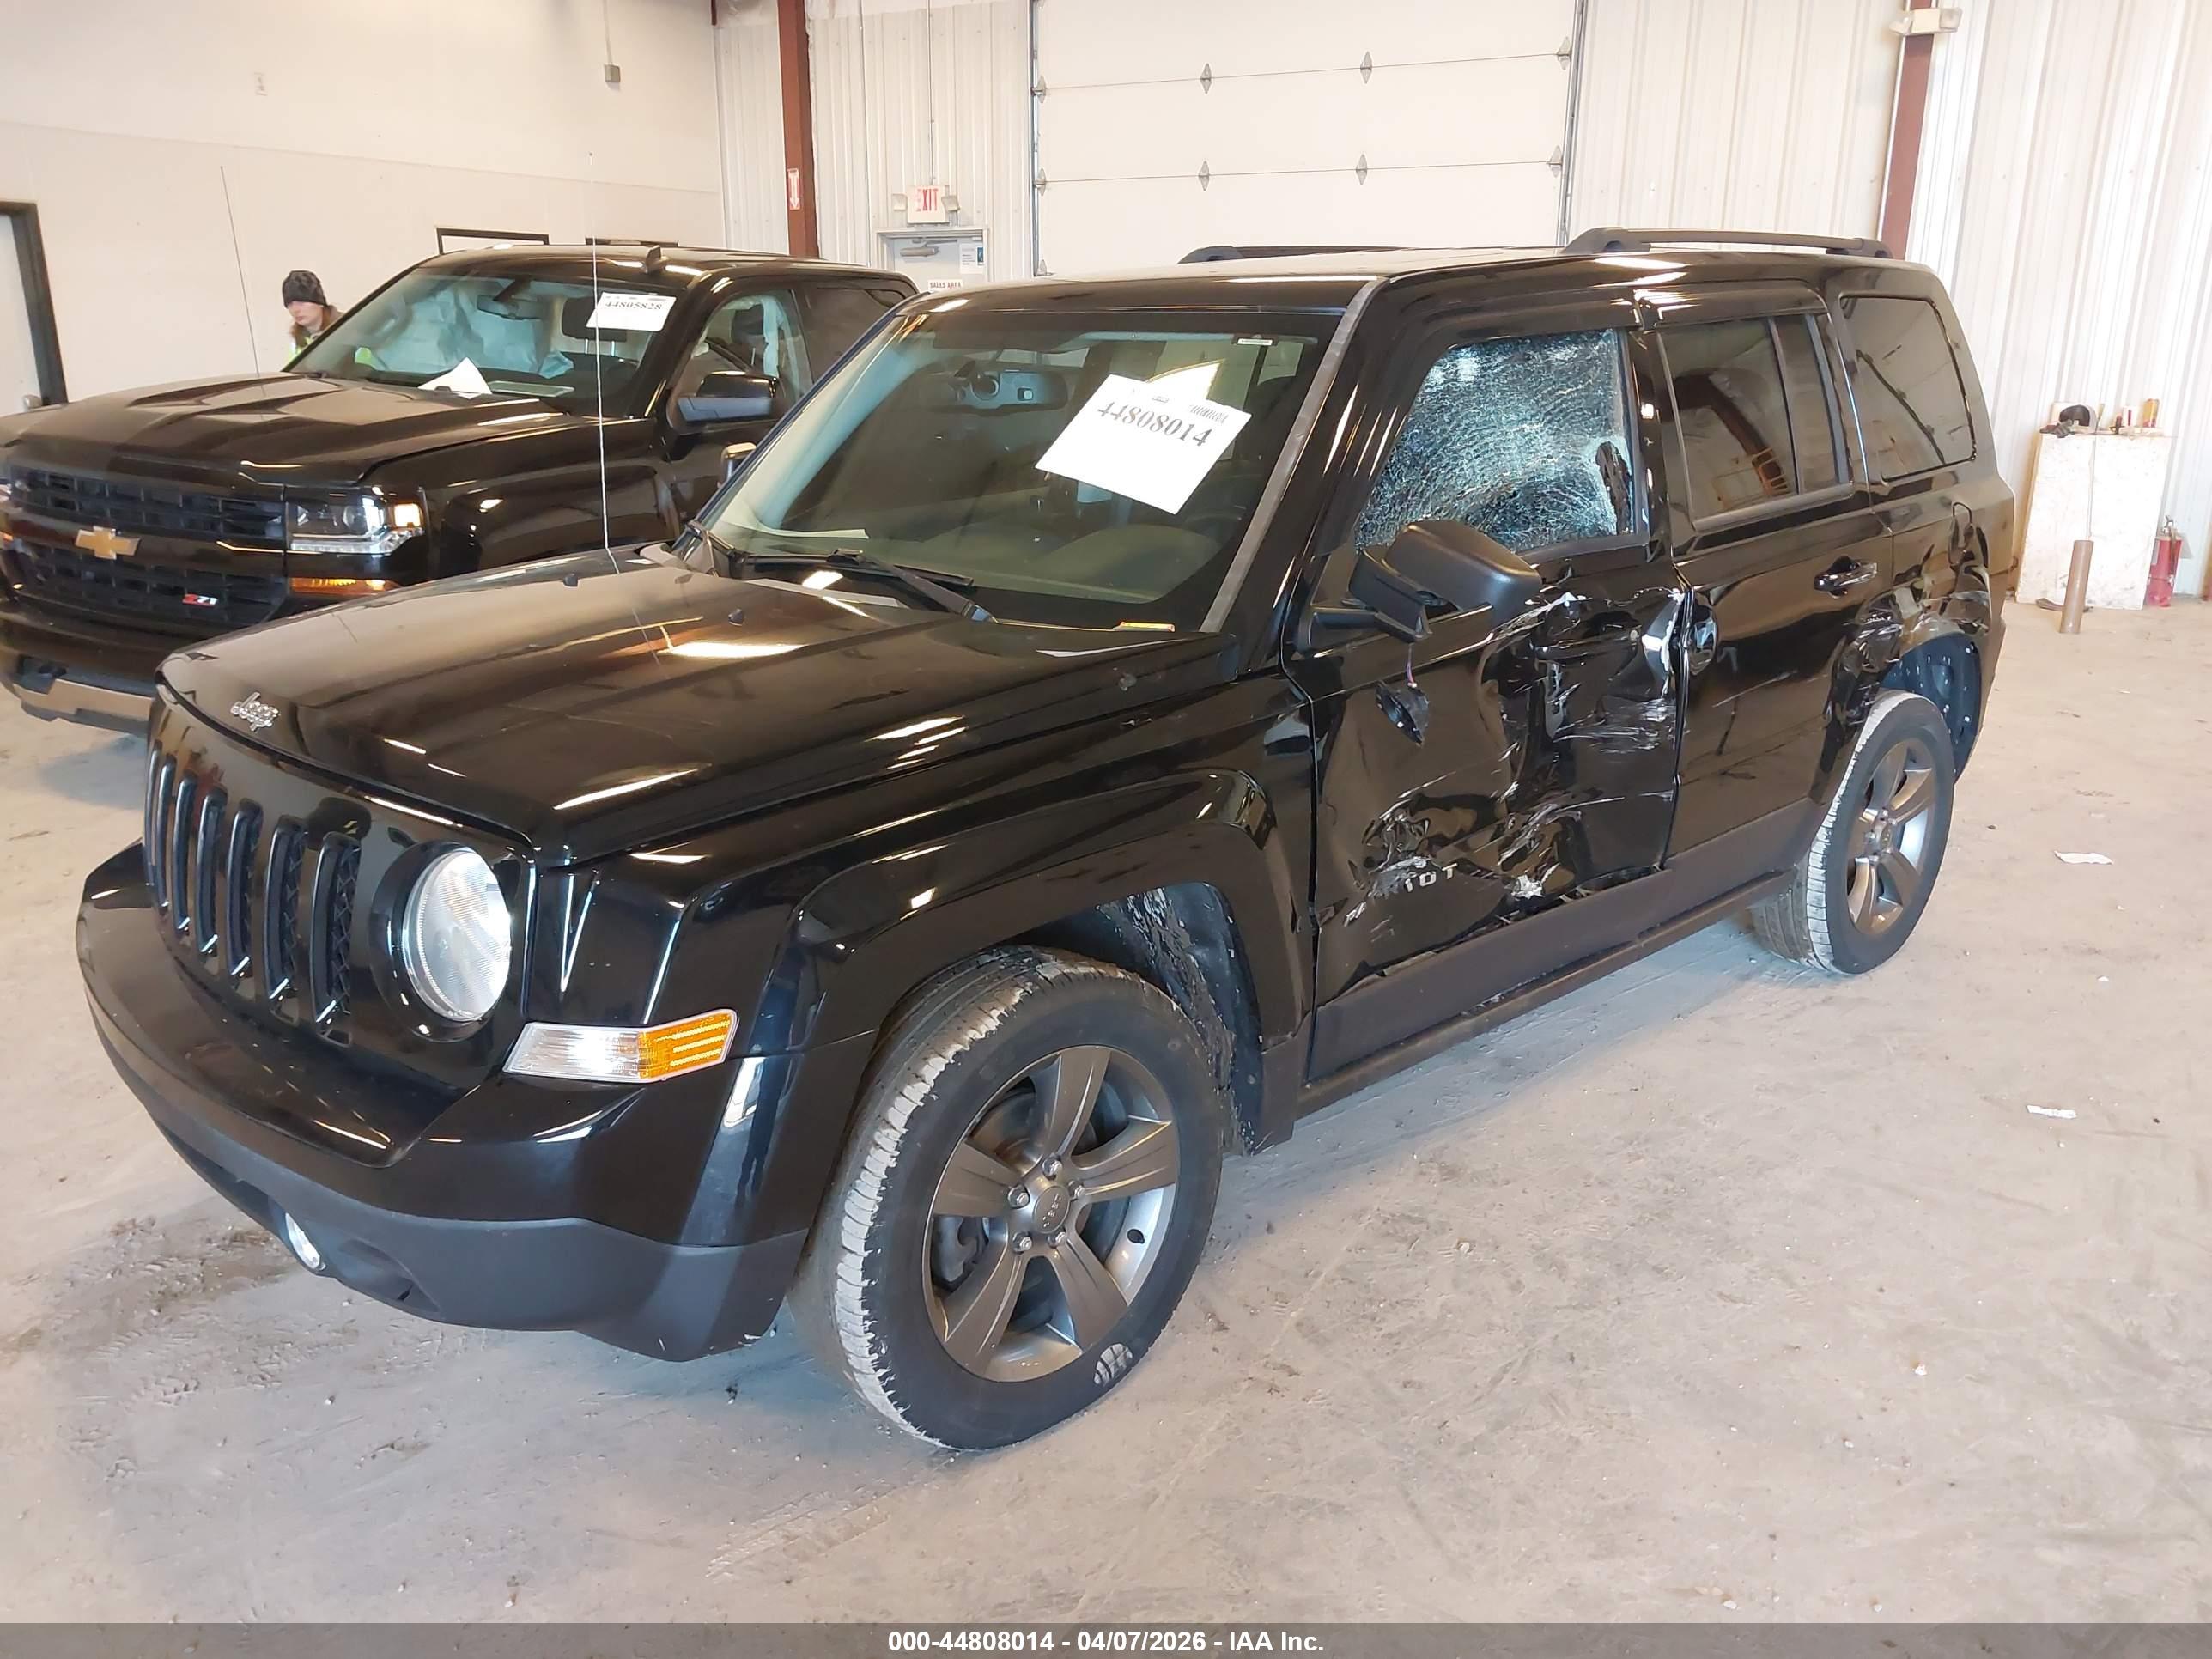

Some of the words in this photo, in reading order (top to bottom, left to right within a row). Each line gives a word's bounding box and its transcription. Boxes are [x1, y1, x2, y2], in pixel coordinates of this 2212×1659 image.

[915, 188, 939, 211] EXIT
[1097, 401, 1212, 447] 44808014
[182, 593, 218, 605] Z71
